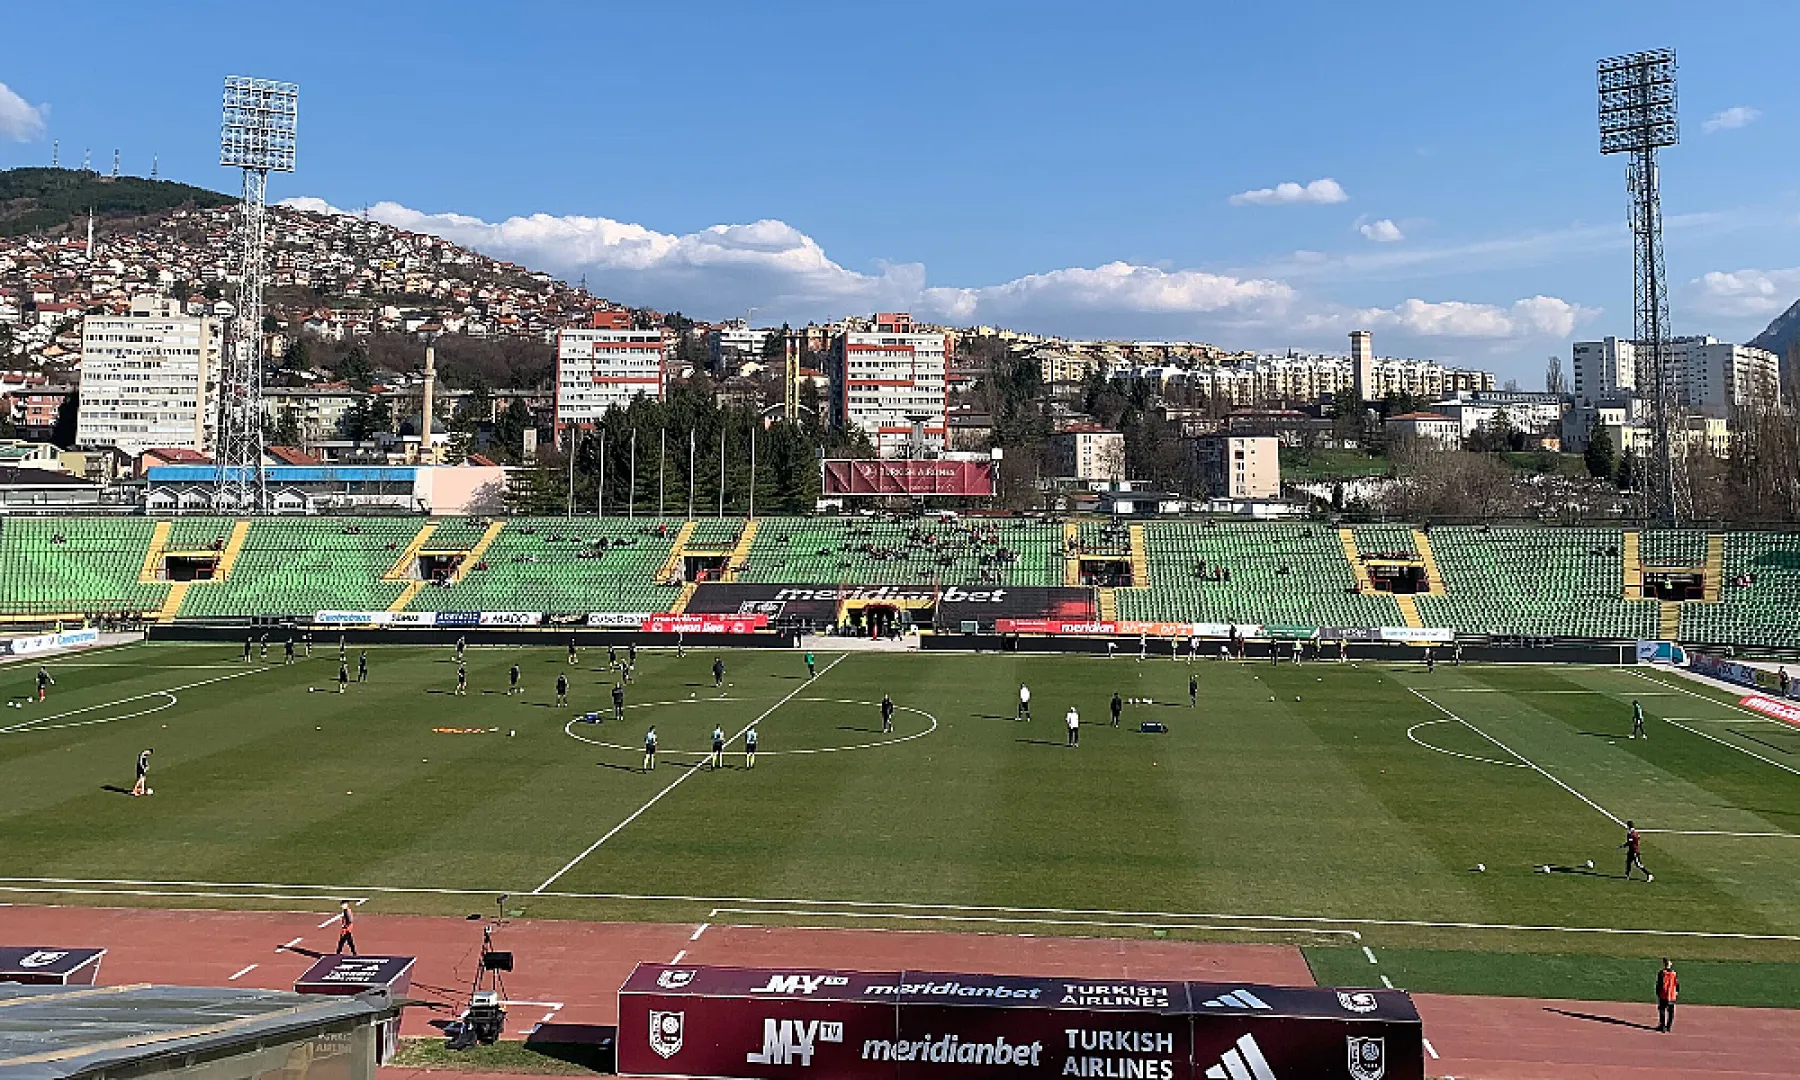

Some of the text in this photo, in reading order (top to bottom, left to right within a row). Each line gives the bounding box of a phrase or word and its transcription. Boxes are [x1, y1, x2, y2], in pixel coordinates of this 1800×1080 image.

[776, 587, 1006, 602] meridianbet
[1061, 621, 1115, 632] meridian
[864, 982, 1042, 999] meridianbet
[1063, 984, 1168, 996] TURKISH
[1060, 995, 1169, 1007] AIRLINES
[1065, 1029, 1173, 1053] TURKISH
[862, 1033, 1043, 1066] meridianbet
[1062, 1056, 1173, 1080] AIRLINES
